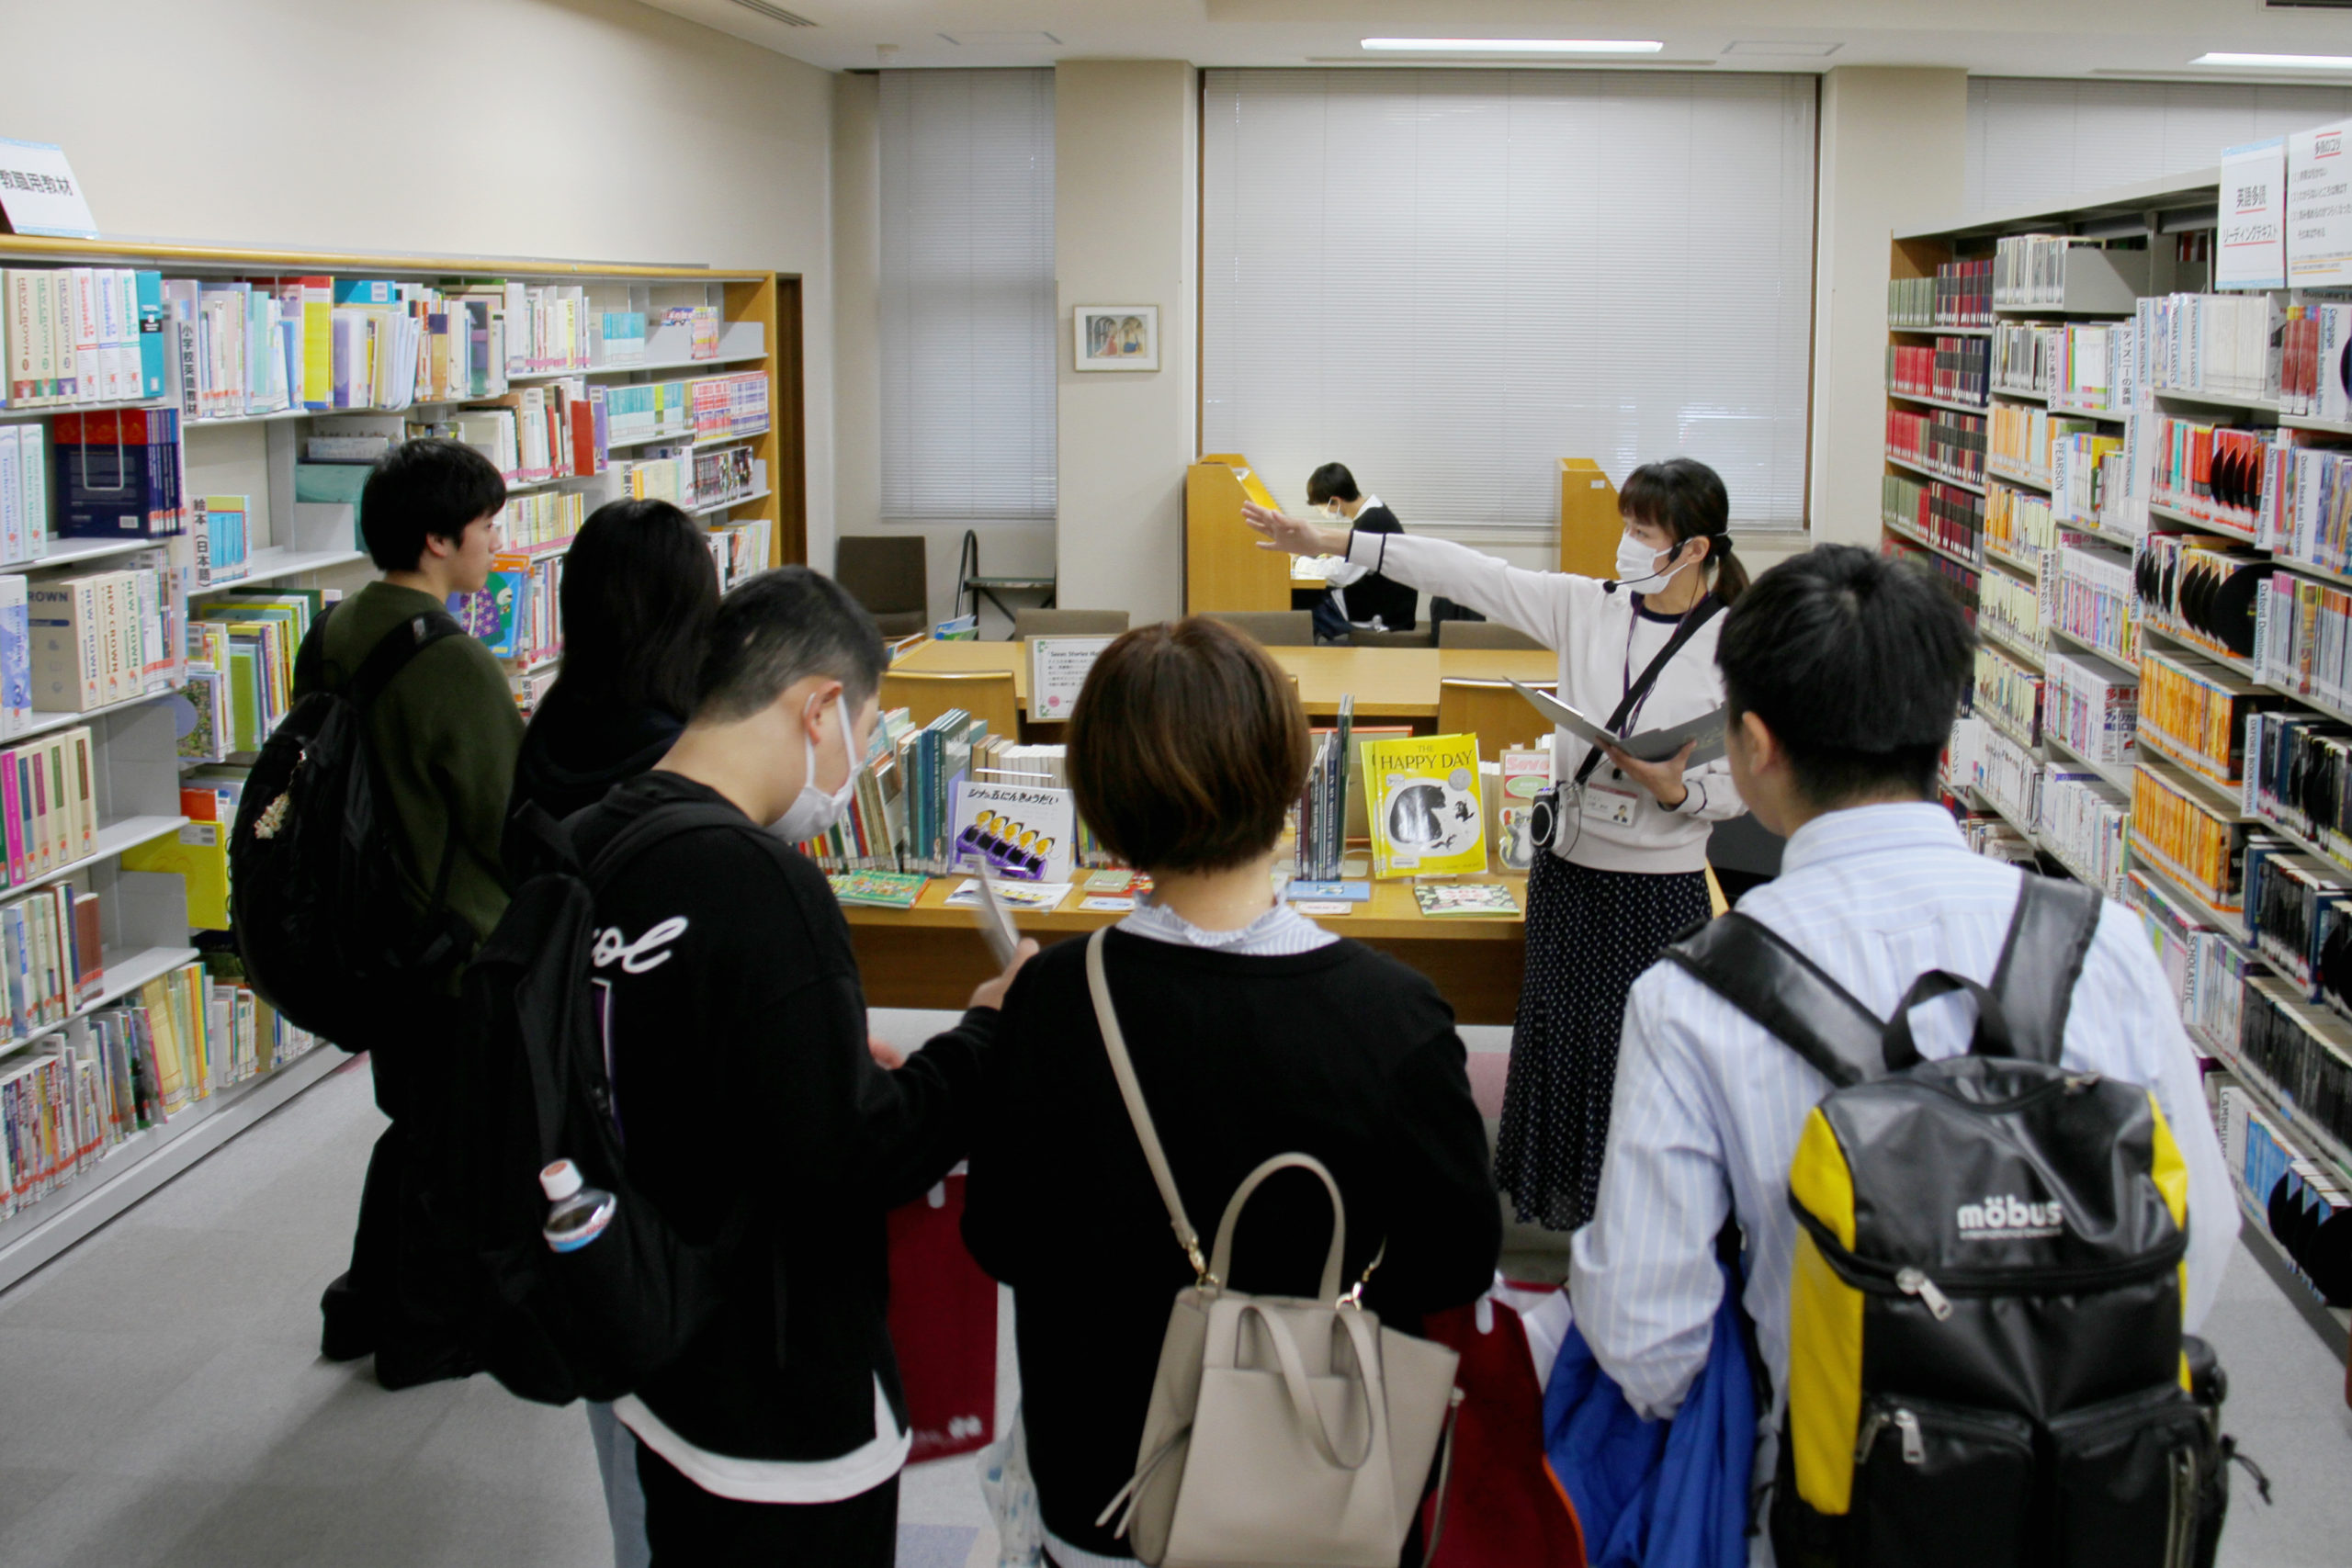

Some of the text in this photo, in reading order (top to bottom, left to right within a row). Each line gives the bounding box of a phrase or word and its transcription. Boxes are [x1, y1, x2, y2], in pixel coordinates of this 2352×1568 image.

[0, 170, 74, 196] 教職用教材
[2236, 185, 2267, 208] 英語多読
[2223, 224, 2278, 243] リーディングテキスト
[181, 325, 197, 414] 小学校英語教材
[2056, 443, 2064, 491] PEARSON
[85, 589, 96, 679] NEW CROWN
[107, 584, 119, 673] NEW CROWN
[130, 615, 138, 668] CROWN
[2255, 583, 2269, 671] Oxford Dominoes
[1381, 749, 1474, 770] HAPPY DAY
[1418, 745, 1434, 753] THE
[2245, 719, 2258, 815] OXFORD BOOKWORMS
[2186, 935, 2198, 1005] SCHOLASTIC
[1957, 1194, 2064, 1229] möbus
